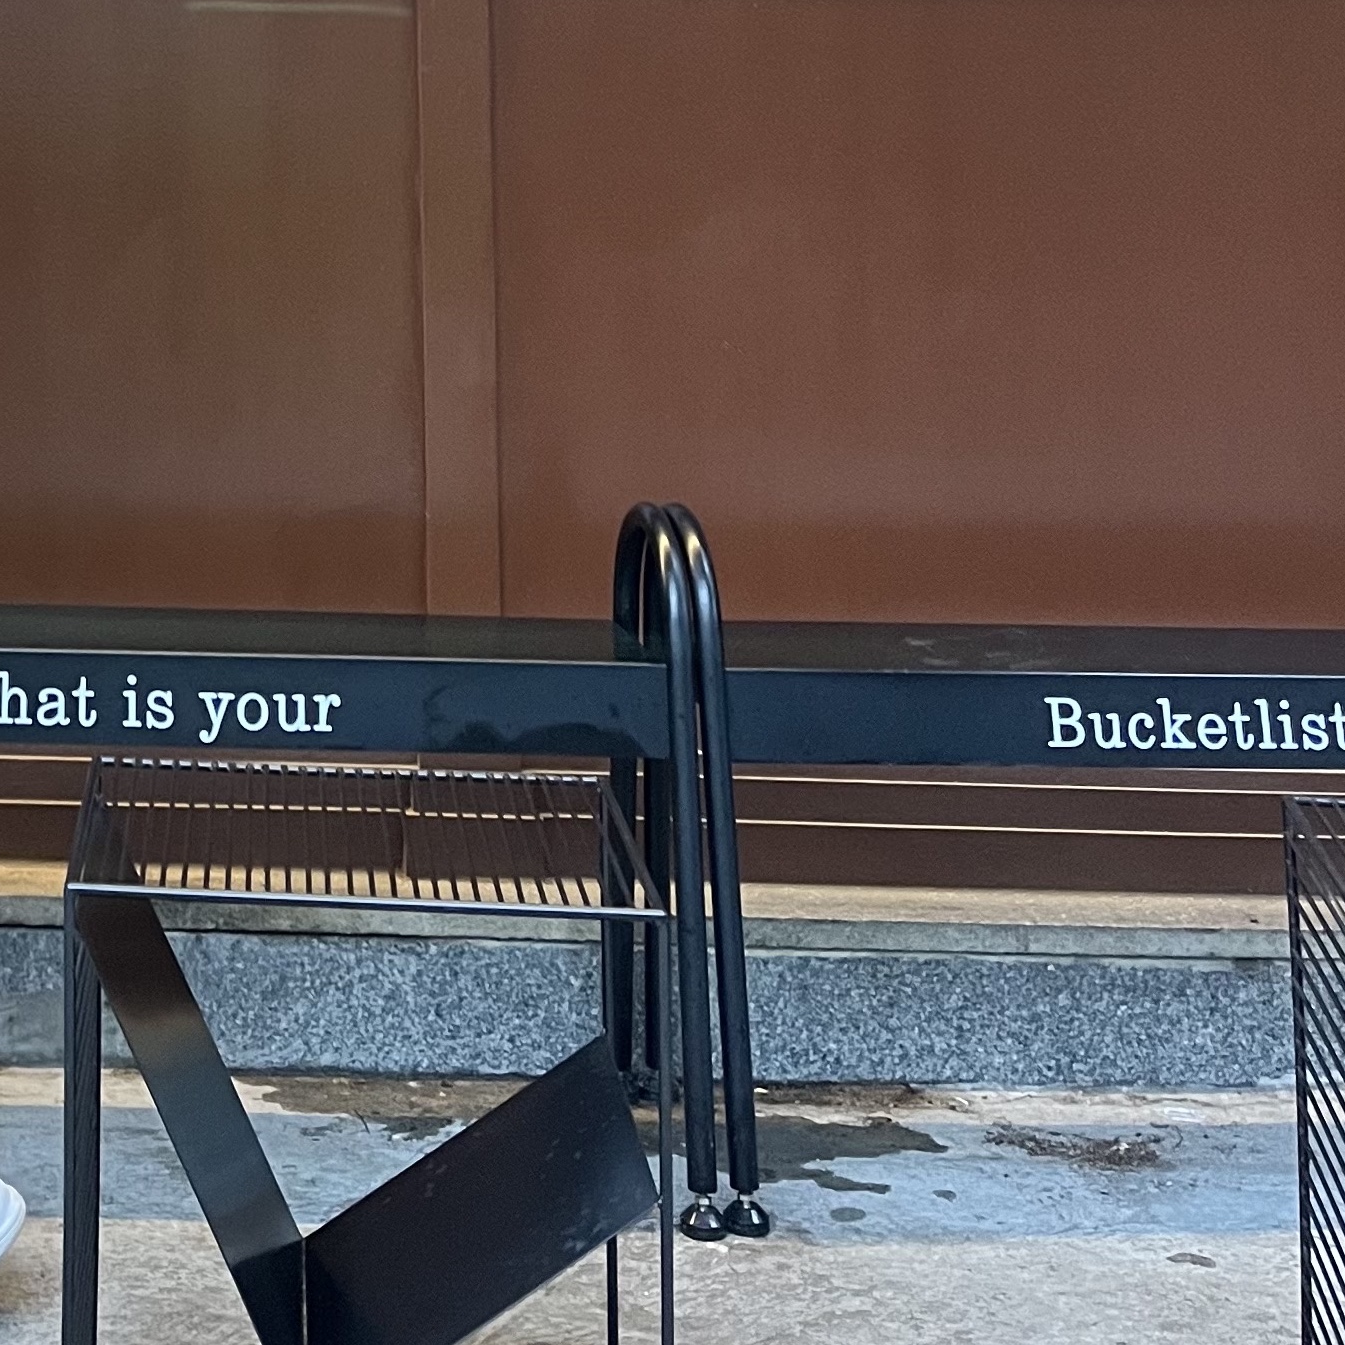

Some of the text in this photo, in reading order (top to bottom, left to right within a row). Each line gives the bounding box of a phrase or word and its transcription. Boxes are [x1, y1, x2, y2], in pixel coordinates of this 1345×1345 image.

[121, 674, 175, 730] is
[198, 689, 342, 744] your
[1043, 696, 1345, 751] Bucketlist
